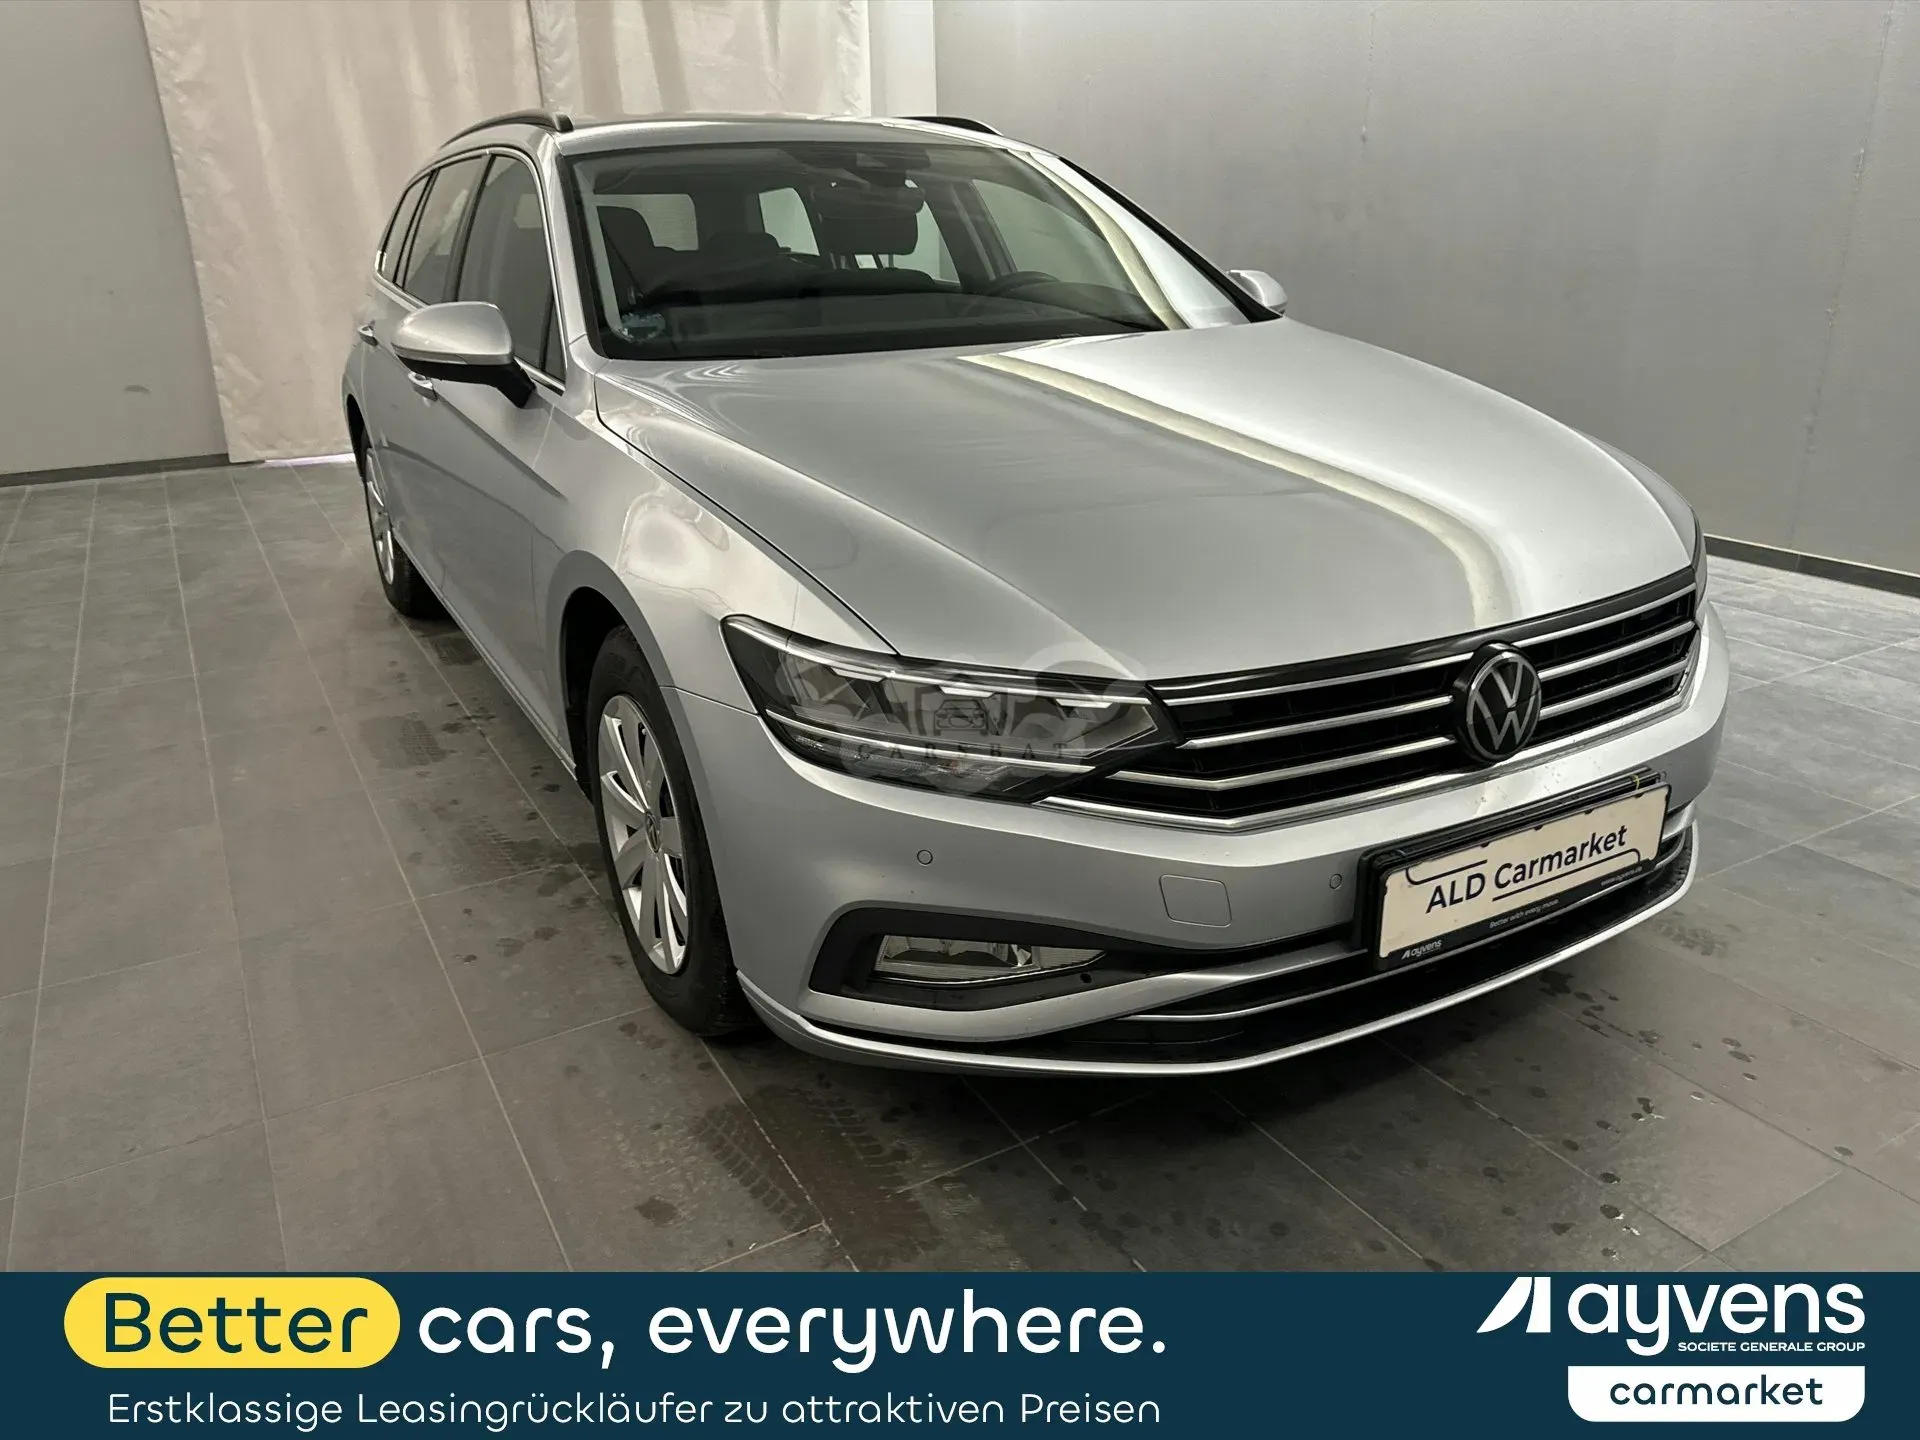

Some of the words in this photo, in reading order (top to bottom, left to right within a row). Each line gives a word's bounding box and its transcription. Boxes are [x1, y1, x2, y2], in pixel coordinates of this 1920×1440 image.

[1425, 872, 1487, 915] ALD
[1493, 824, 1628, 890] Carmarket
[1410, 939, 1443, 958] ayvens
